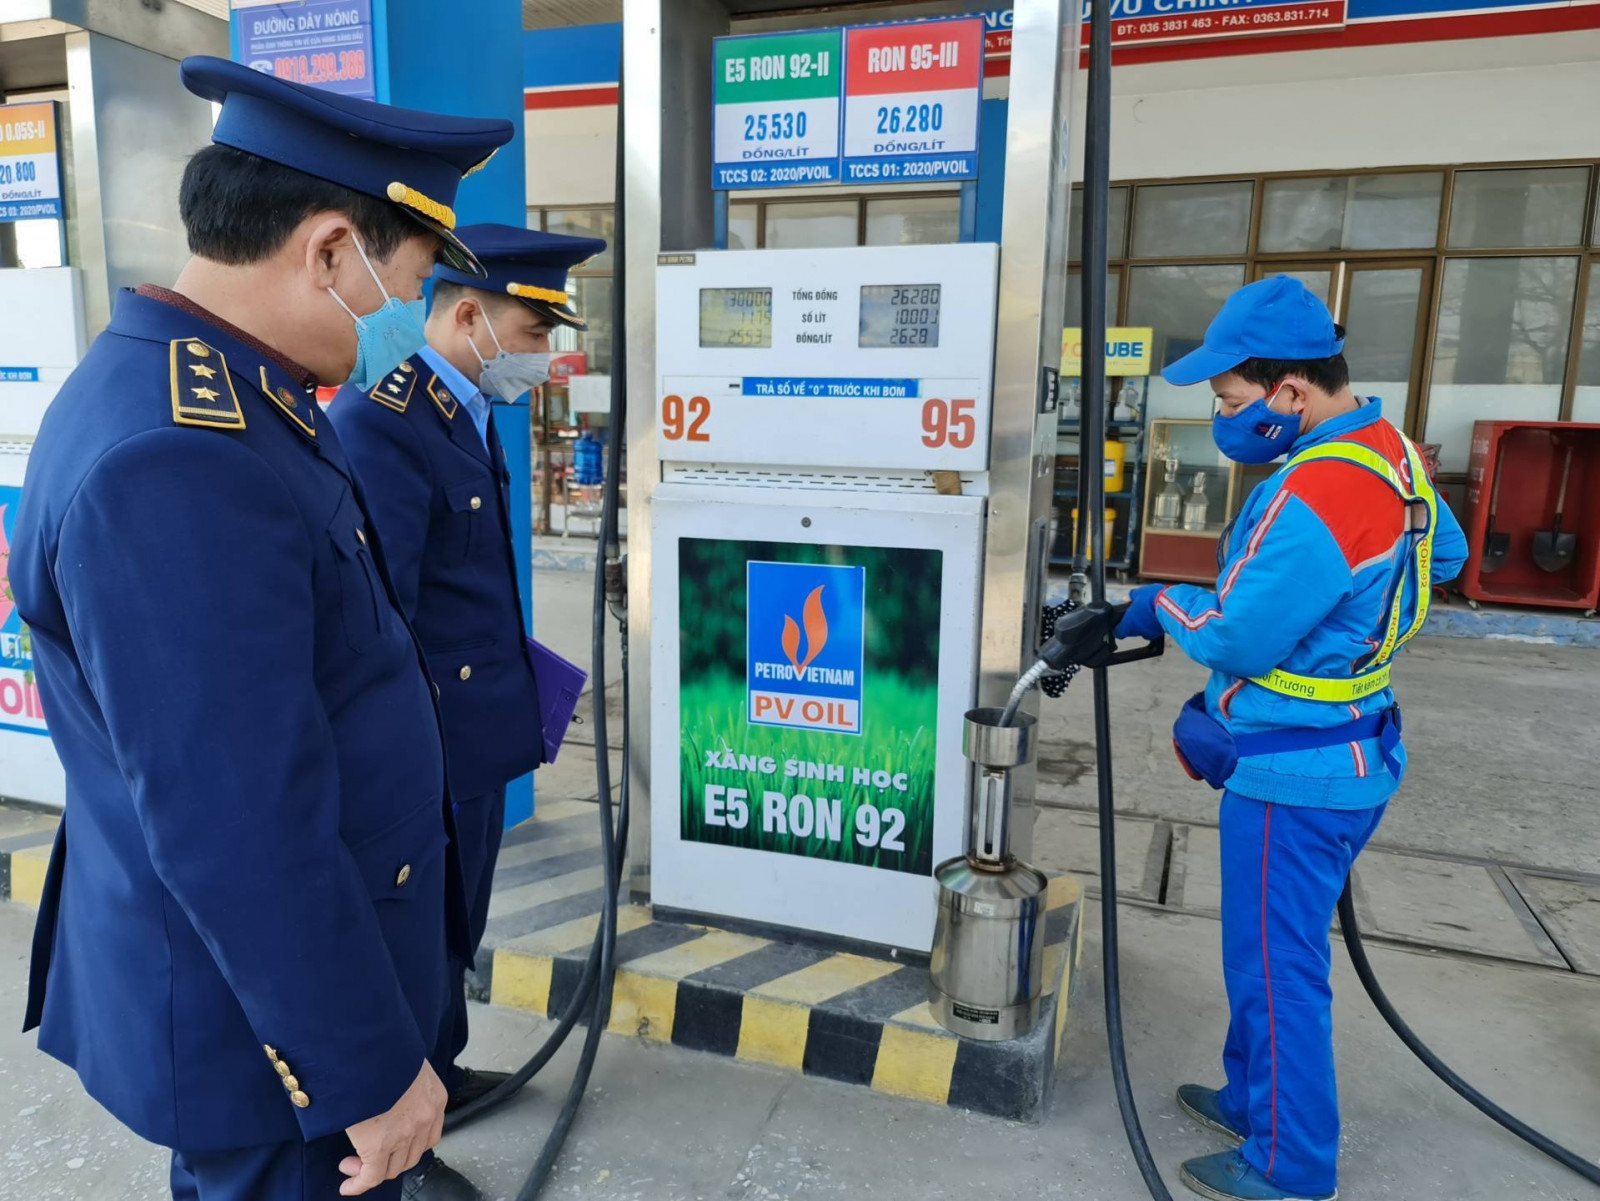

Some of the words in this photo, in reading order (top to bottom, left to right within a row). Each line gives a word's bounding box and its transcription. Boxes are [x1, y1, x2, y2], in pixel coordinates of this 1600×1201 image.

[253, 16, 295, 36] ĐƯỜNG
[298, 12, 322, 31] DÂY
[1140, 22, 1160, 34] 036
[1162, 20, 1188, 32] 3831
[1191, 18, 1212, 29] 463
[1222, 14, 1250, 27] FAX:
[1253, 8, 1330, 25] 0363.831.714
[725, 57, 746, 83] E5
[750, 54, 786, 82] RON
[790, 51, 830, 79] 92-II
[868, 45, 906, 73] RON
[910, 41, 959, 71] 95-III
[720, 169, 748, 184] TCCS
[751, 169, 767, 182] 02:
[770, 165, 832, 182] 2020/PVOIL
[849, 164, 880, 178] TCCS
[882, 163, 900, 176] 01:
[903, 160, 969, 177] 2020/PVOIL
[890, 288, 939, 305] 26280
[801, 310, 813, 323] SỐ
[814, 311, 826, 323] LÍT
[1105, 341, 1143, 357] UBE
[756, 380, 775, 395] TRẢ
[777, 380, 791, 395] SỐ
[827, 382, 862, 396] TRƯỚC
[863, 386, 881, 397] KHI
[882, 386, 906, 397] BƠM
[662, 394, 711, 443] 92
[921, 398, 976, 449] 95
[755, 662, 854, 686] PETROVIETNAM
[755, 695, 795, 720] PV
[801, 700, 853, 727] OIL
[705, 748, 777, 775] XĂNG
[784, 758, 845, 783] SINH
[852, 767, 908, 793] HỌC
[704, 783, 749, 829] E5
[762, 790, 842, 842] RON
[855, 803, 906, 852] 92
